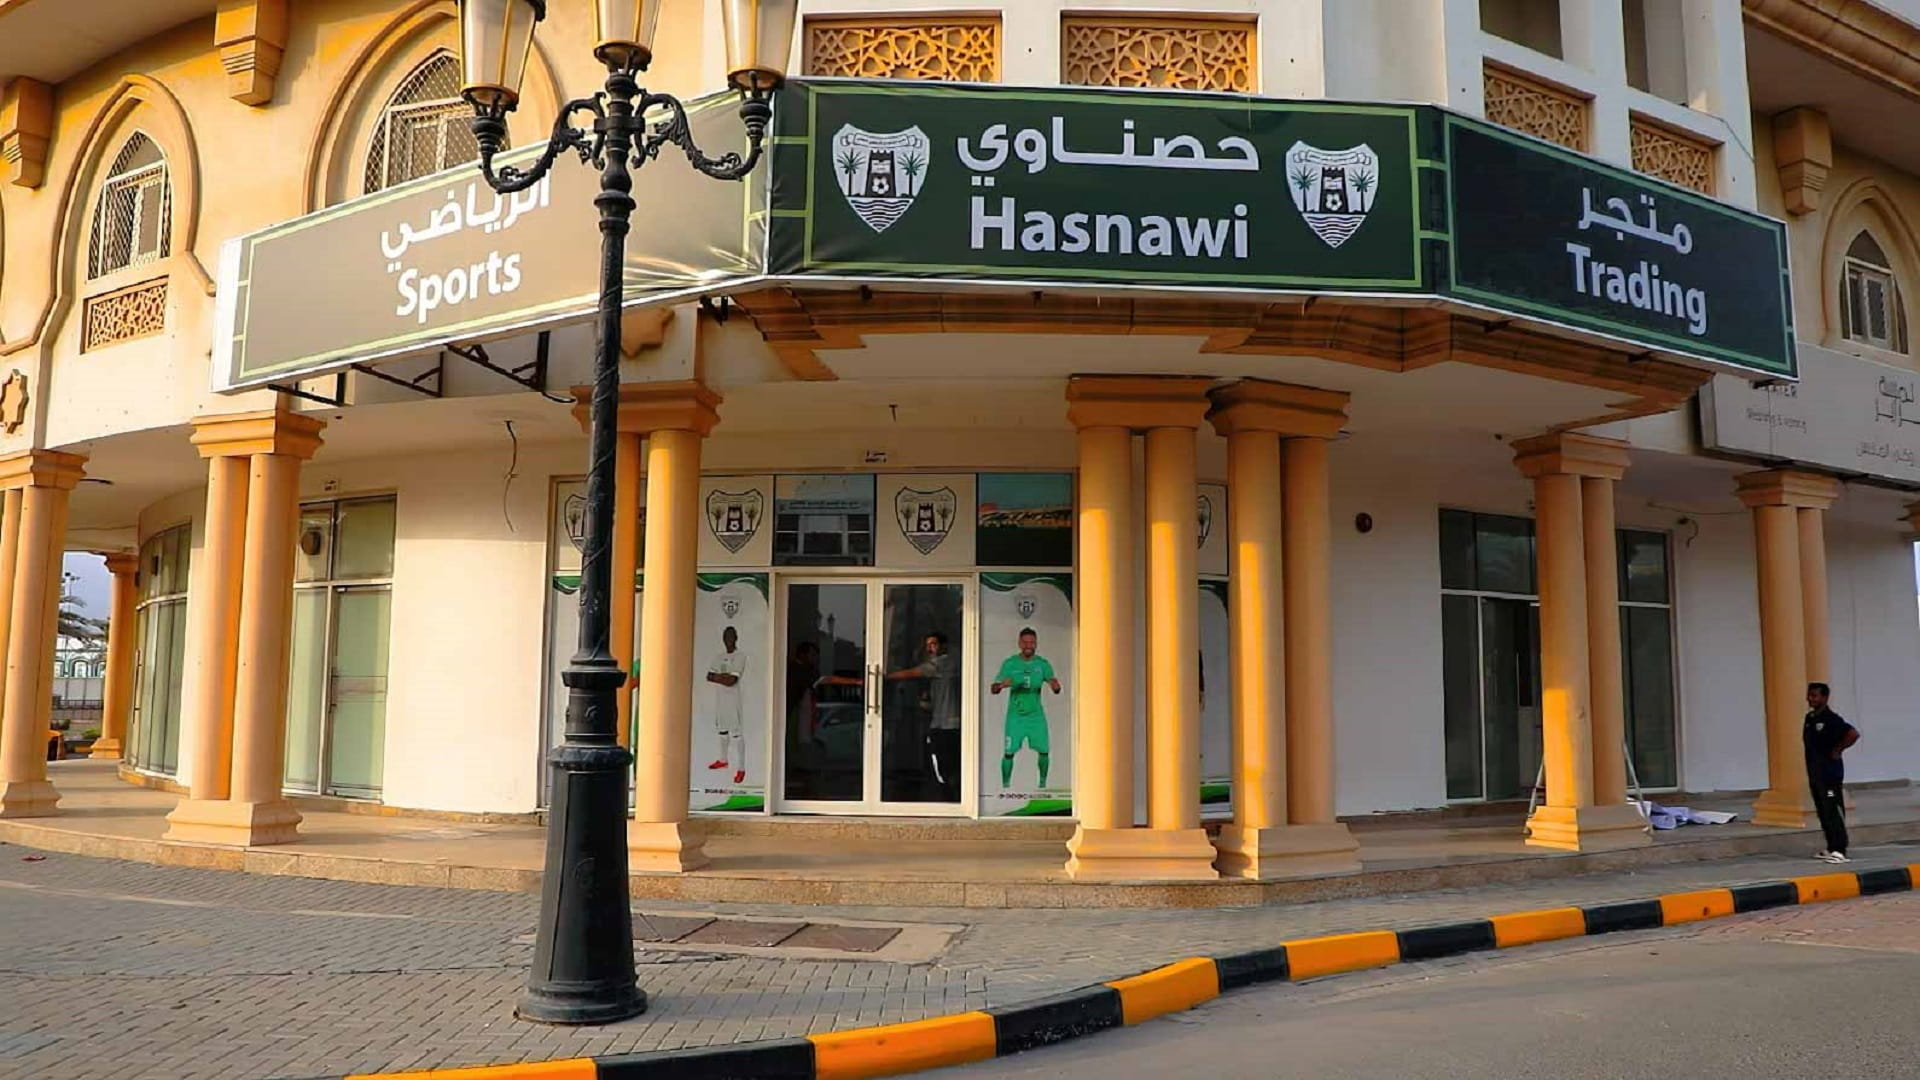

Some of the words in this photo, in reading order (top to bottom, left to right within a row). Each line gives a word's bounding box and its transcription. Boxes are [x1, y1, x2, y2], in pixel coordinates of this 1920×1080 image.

[957, 116, 1260, 187] حصناوي
[971, 196, 1248, 258] Hasnawi
[1579, 187, 1693, 254] متجر
[396, 250, 521, 324] Sports
[1566, 242, 1706, 335] Trading
